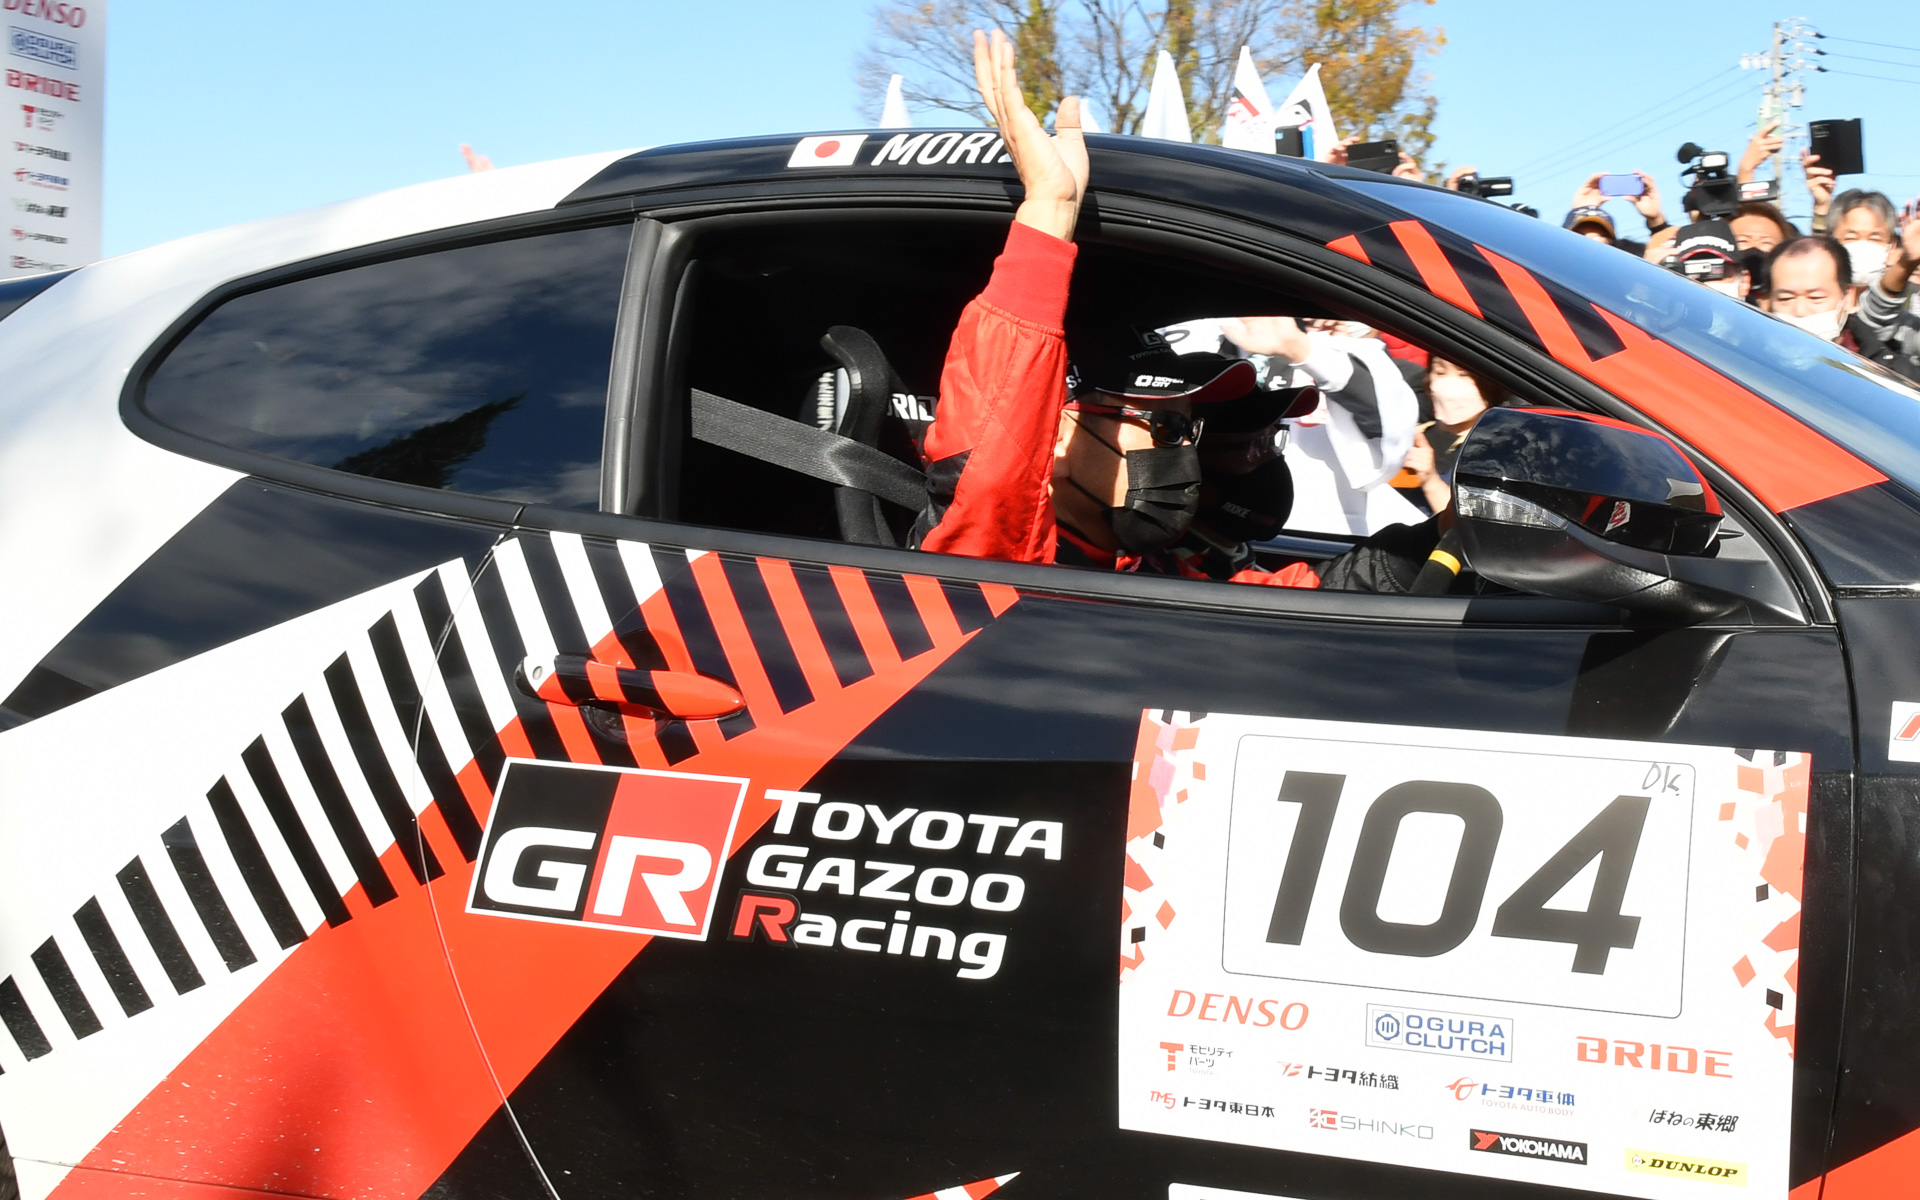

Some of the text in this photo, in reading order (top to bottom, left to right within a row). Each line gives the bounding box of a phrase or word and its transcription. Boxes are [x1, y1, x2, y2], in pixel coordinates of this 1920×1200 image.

[6, 69, 80, 102] BRIDE
[871, 133, 1013, 166] MORI
[764, 789, 1063, 860] TOYOTA
[483, 827, 712, 926] GR
[746, 844, 1025, 912] GAZOO
[1265, 771, 1651, 975] 104
[734, 893, 1007, 979] Racing
[1167, 989, 1309, 1030] DENSO
[1405, 1014, 1505, 1038] OGURA
[1189, 1044, 1234, 1058] モビリティ
[1405, 1031, 1505, 1056] CLUTCH
[1576, 1036, 1733, 1079] BRIDE
[1308, 1066, 1400, 1090] トヨタ紡織
[1183, 1096, 1275, 1118] トヨタ東日本
[1481, 1083, 1575, 1106] トヨタ車体
[1481, 1099, 1575, 1117] TOYOTA AUTO BODY
[1341, 1115, 1434, 1140] SHINKO
[1649, 1109, 1739, 1133] ばねの東郷
[1498, 1136, 1584, 1161] YOKOHAMA
[1648, 1158, 1738, 1177] DUNLOP
